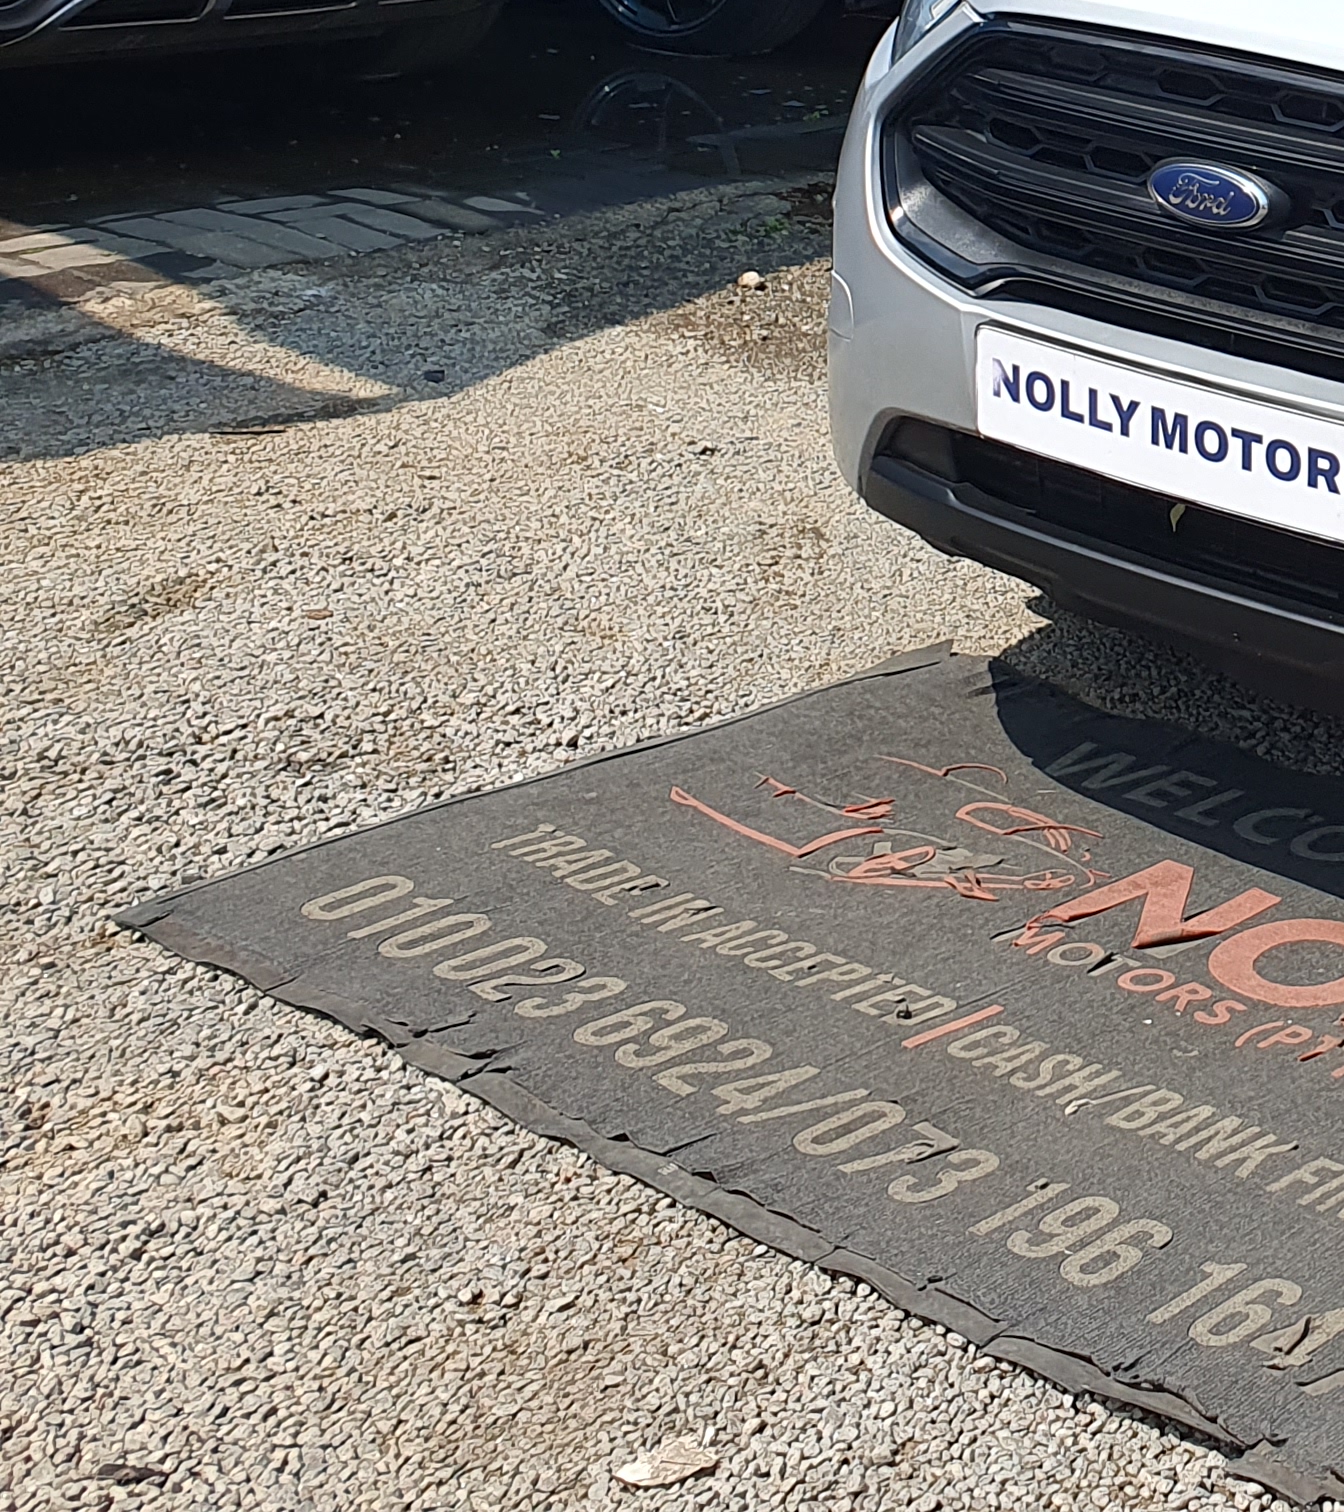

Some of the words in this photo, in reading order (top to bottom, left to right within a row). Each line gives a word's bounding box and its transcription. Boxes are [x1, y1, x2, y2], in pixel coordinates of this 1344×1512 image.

[1168, 172, 1235, 216] Ford
[992, 357, 1141, 438] NOLLY
[490, 823, 670, 906] TRADE
[627, 892, 725, 933] IN
[679, 919, 958, 1026] ACCEPTED
[1013, 925, 1247, 1026] MOTORS
[300, 875, 492, 959] 010
[432, 936, 628, 1019] 023
[572, 999, 1001, 1204] 6924/073
[967, 1177, 1174, 1287] 196
